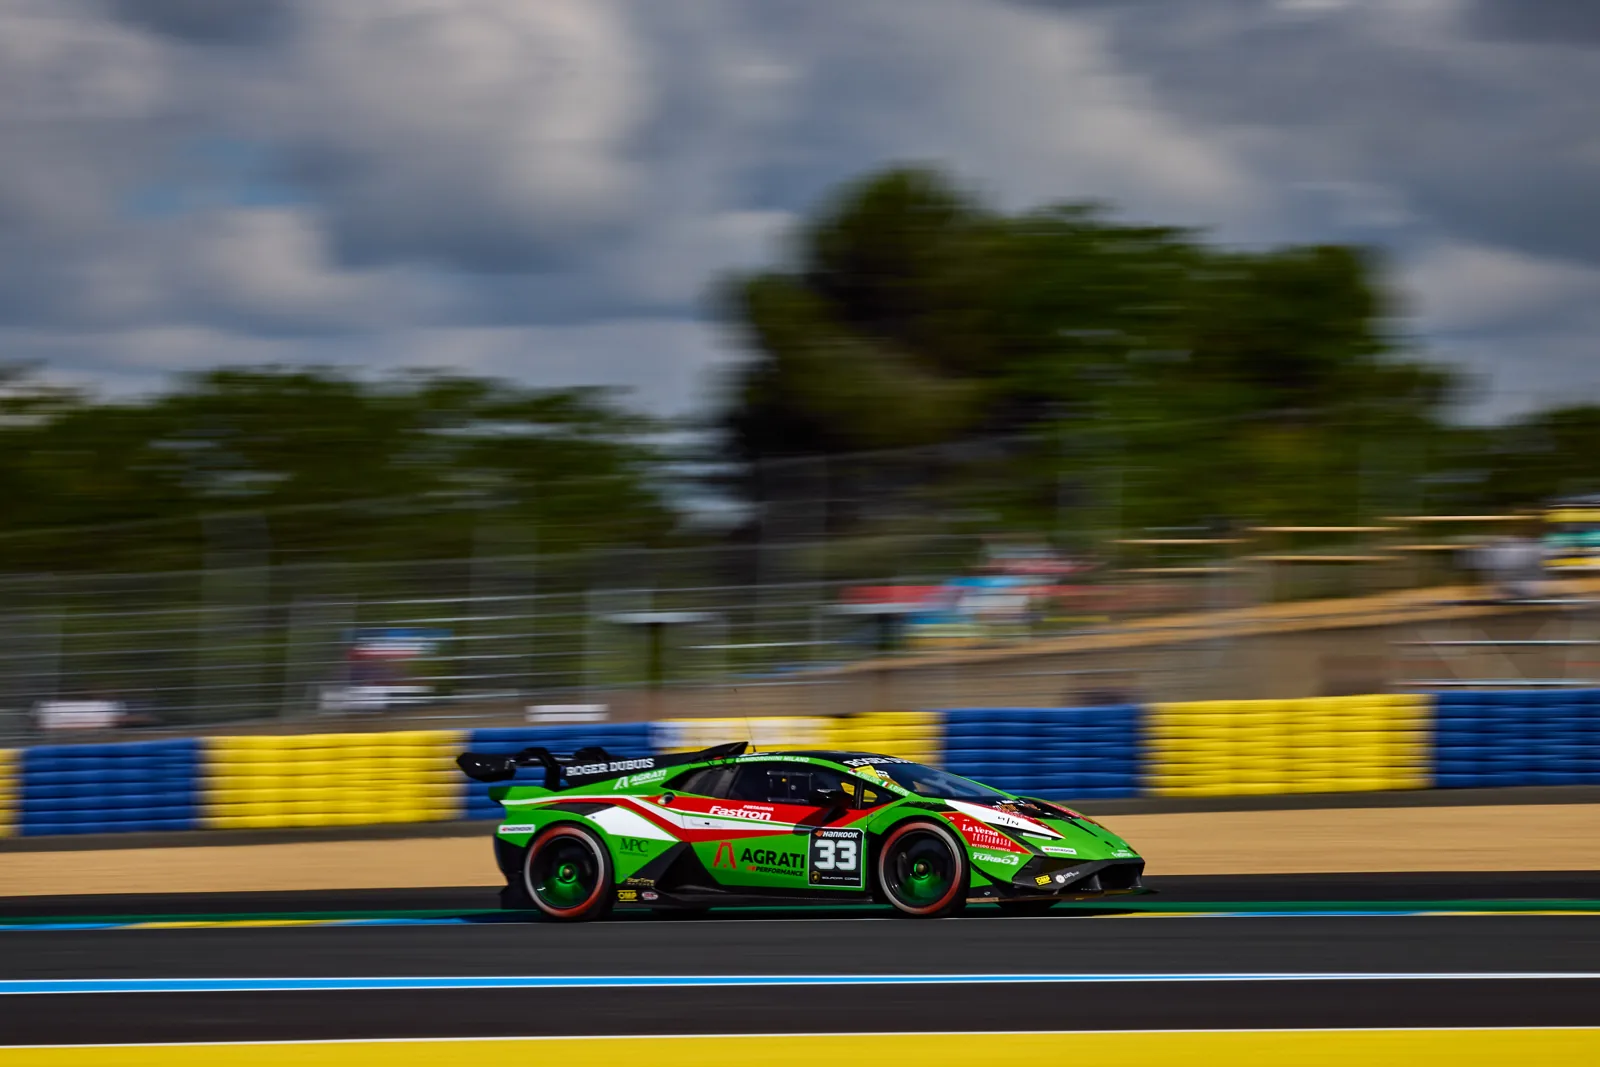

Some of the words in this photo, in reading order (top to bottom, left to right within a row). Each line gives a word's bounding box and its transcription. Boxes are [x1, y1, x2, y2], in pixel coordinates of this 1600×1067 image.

[565, 763, 608, 776] ROGER
[609, 758, 655, 772] DUBUIS
[630, 769, 667, 783] AGRATI
[709, 805, 771, 821] Fastron
[962, 824, 974, 833] La
[620, 838, 649, 853] MPC
[972, 833, 1012, 848] TESTAROSSA
[740, 848, 805, 869] AGRATI
[814, 839, 857, 871] 33
[755, 866, 804, 877] PERFORMANCE
[618, 892, 637, 900] OMP
